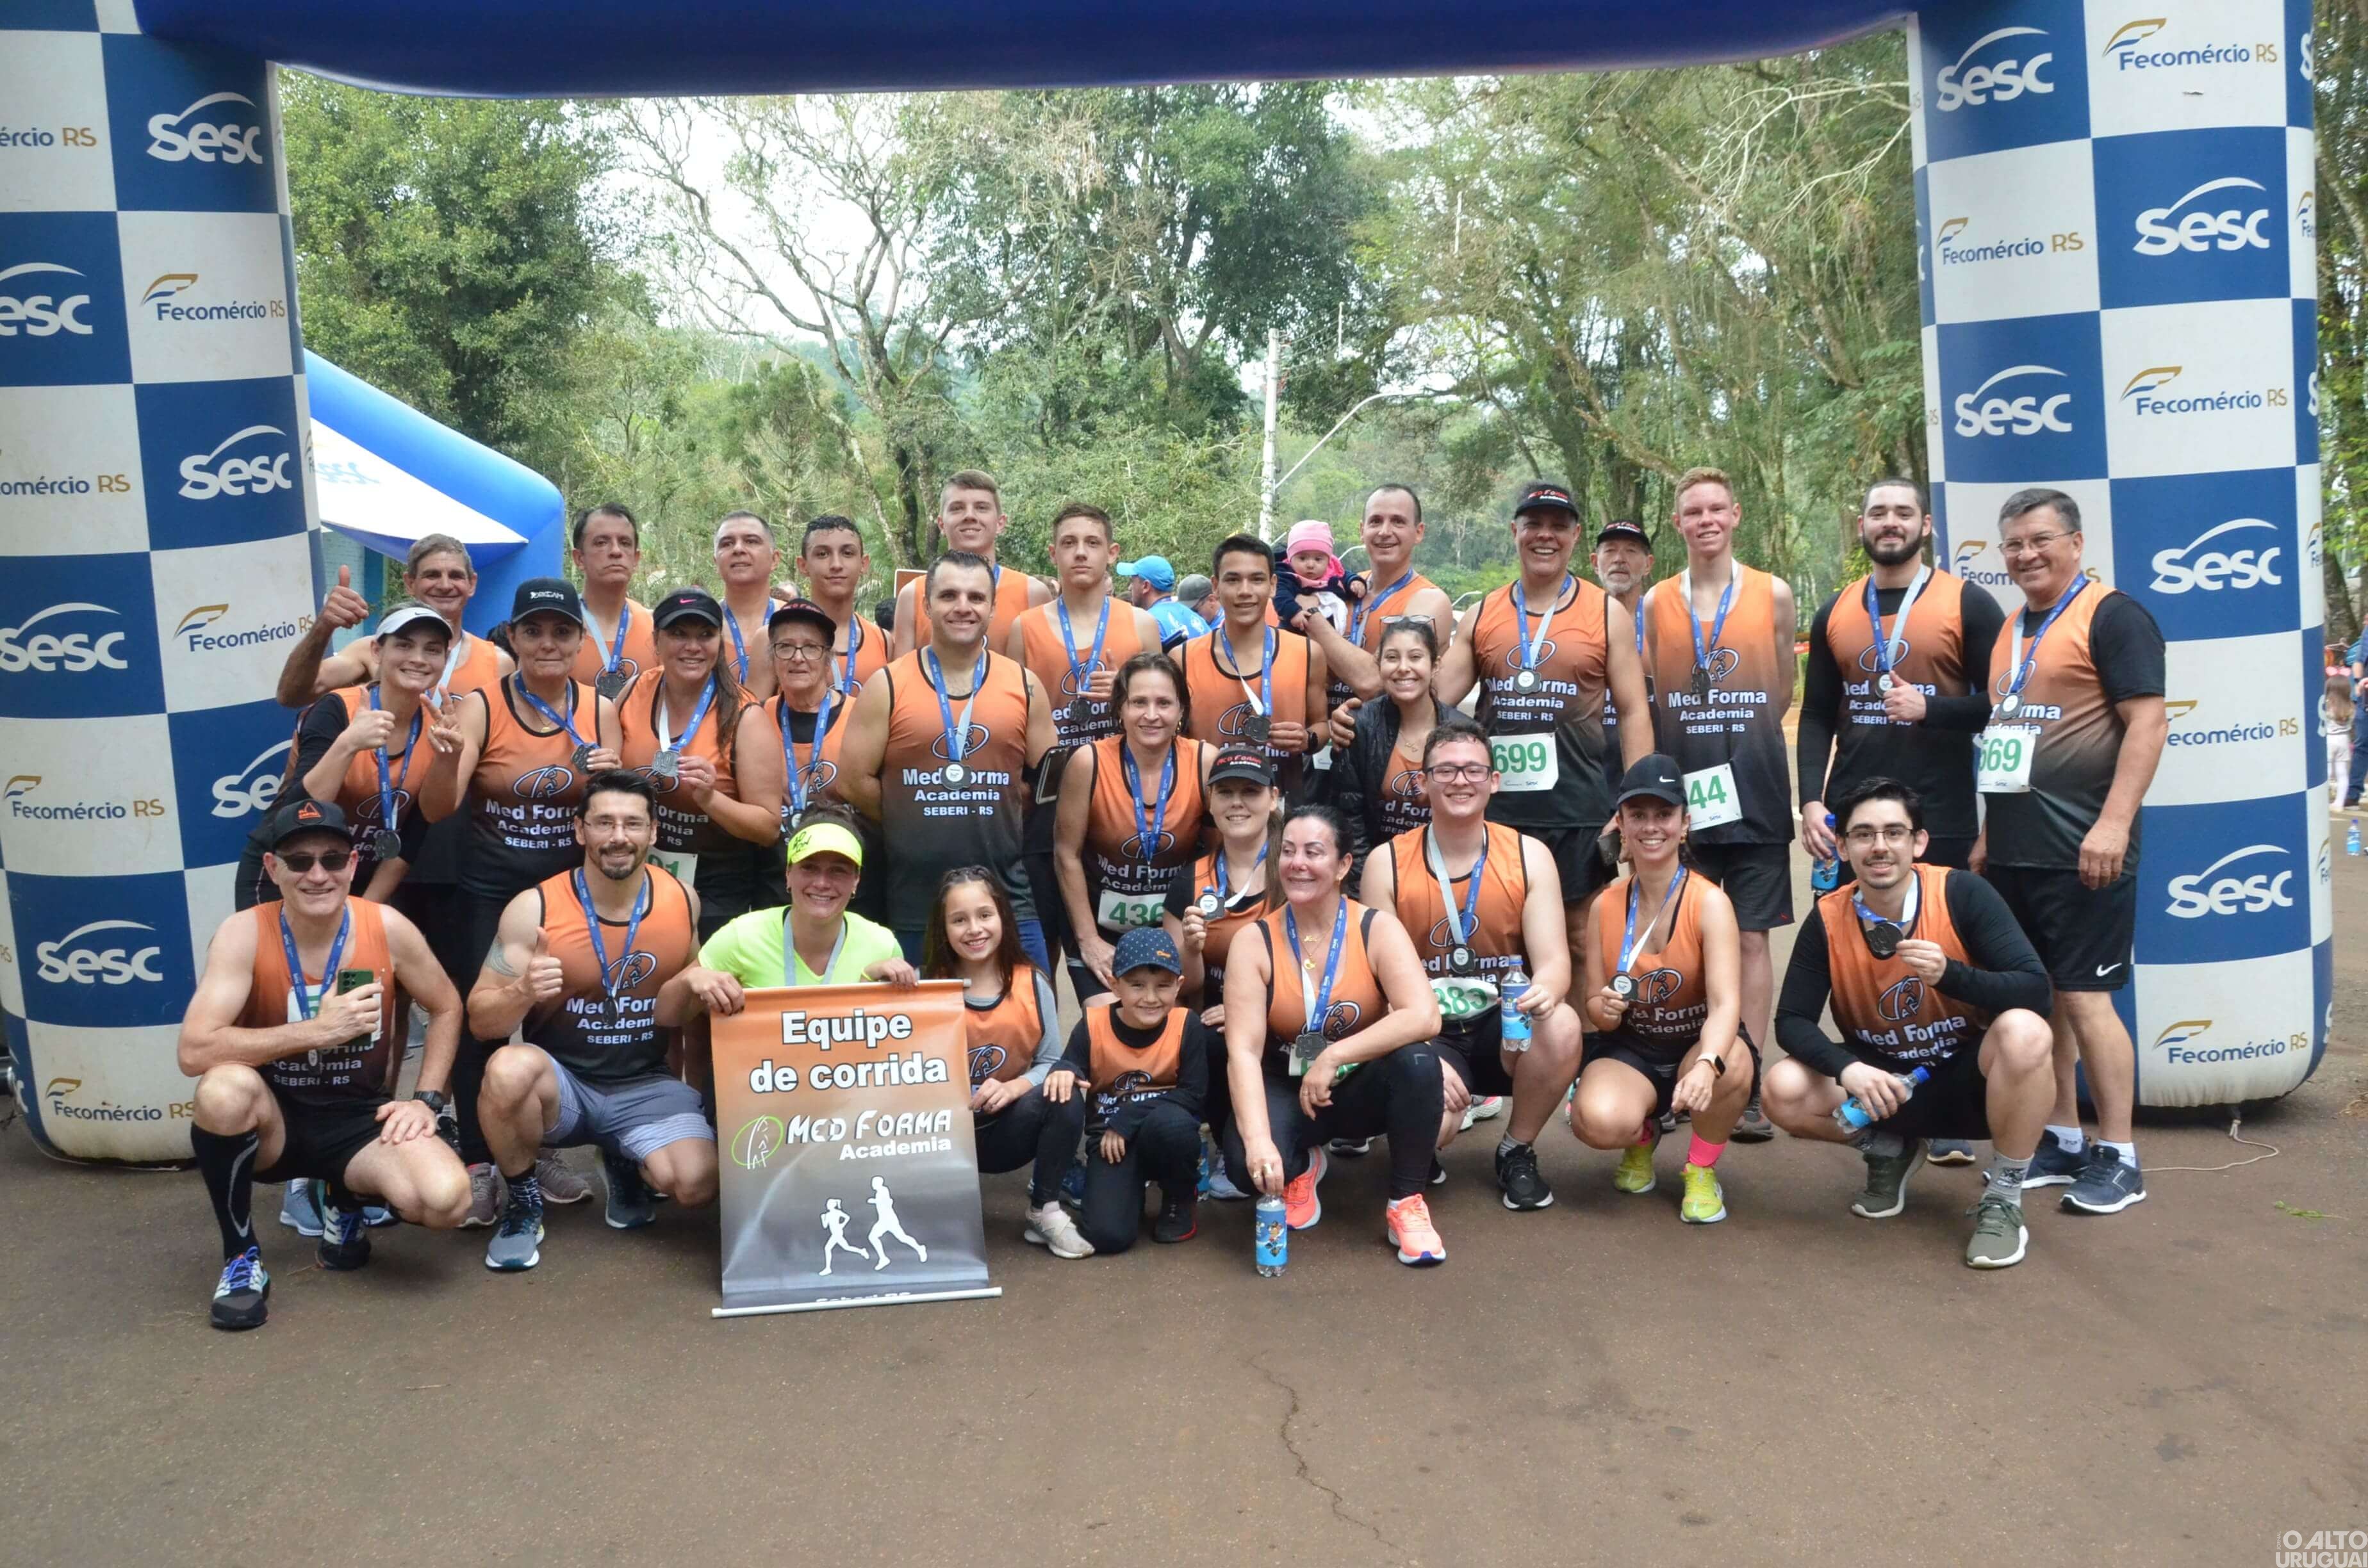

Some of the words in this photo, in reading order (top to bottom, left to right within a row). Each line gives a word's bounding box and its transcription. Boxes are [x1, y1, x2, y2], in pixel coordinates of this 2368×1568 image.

[2119, 44, 2249, 70] Fecomércio
[2256, 44, 2277, 63] RS
[1937, 53, 2054, 111] Sesc
[63, 127, 97, 147] RS
[146, 114, 262, 164] Sesc
[2133, 208, 2270, 256] Sesc
[1943, 236, 2044, 265] Fecomércio
[2051, 232, 2084, 253] RS
[157, 302, 267, 321] Fecomércio
[270, 300, 285, 318] RS
[2137, 391, 2262, 415] Fecomércio
[2267, 389, 2287, 406] RS
[1955, 393, 2072, 437] Sesc
[98, 474, 130, 493] RS
[179, 453, 292, 500] Sesc
[1961, 566, 2013, 586] Fecom
[2085, 567, 2101, 584] S
[2150, 546, 2281, 594] Sesc
[189, 623, 295, 652] Fecomércio
[299, 614, 314, 633] RS
[0, 628, 127, 673] Sesc
[1538, 680, 1577, 695] rma
[1493, 696, 1564, 709] Academia
[1668, 692, 1701, 708] Med
[1708, 689, 1767, 705] Forma
[1497, 711, 1531, 721] SEBERI
[1541, 712, 1553, 721] RS
[1680, 708, 1754, 721] Academia
[1852, 715, 1887, 725] SEBERI
[1686, 725, 1723, 734] SEBERI
[2167, 723, 2274, 746] ecomércio
[2280, 717, 2298, 735] RS
[1492, 741, 1547, 774] 699
[970, 771, 1009, 785] rma
[211, 774, 284, 818] Se
[914, 789, 999, 801] Academia
[12, 801, 126, 820] Fecomércio
[133, 799, 165, 817] RS
[486, 799, 525, 820] Med
[533, 804, 577, 821] For
[656, 804, 709, 824] orma
[923, 806, 968, 816] SEBERI
[979, 806, 993, 815] RS
[1401, 802, 1433, 817] For
[498, 821, 575, 835] Academia
[505, 837, 548, 849] SEBERI
[558, 837, 572, 849] RS
[667, 836, 682, 846] RS
[1137, 863, 1183, 879] Form
[2166, 871, 2292, 919] Sesc
[37, 942, 163, 985] Sesc
[619, 997, 656, 1013] For
[1654, 1004, 1706, 1022] Form
[587, 1034, 632, 1045] SEBERI
[641, 1031, 654, 1041] RS
[781, 1009, 912, 1050] Equipe
[1856, 1028, 1899, 1046] Med
[1904, 1015, 1966, 1043] Forma
[2168, 1041, 2285, 1064] Fecomércio
[2290, 1033, 2307, 1052] RS
[274, 1074, 320, 1086] SEBERI
[333, 1075, 350, 1085] RS
[749, 1059, 799, 1093] de
[809, 1052, 949, 1090] corrida
[54, 1100, 161, 1122] Fecomércio
[169, 1101, 194, 1119] RS
[839, 1136, 952, 1161] Academia
